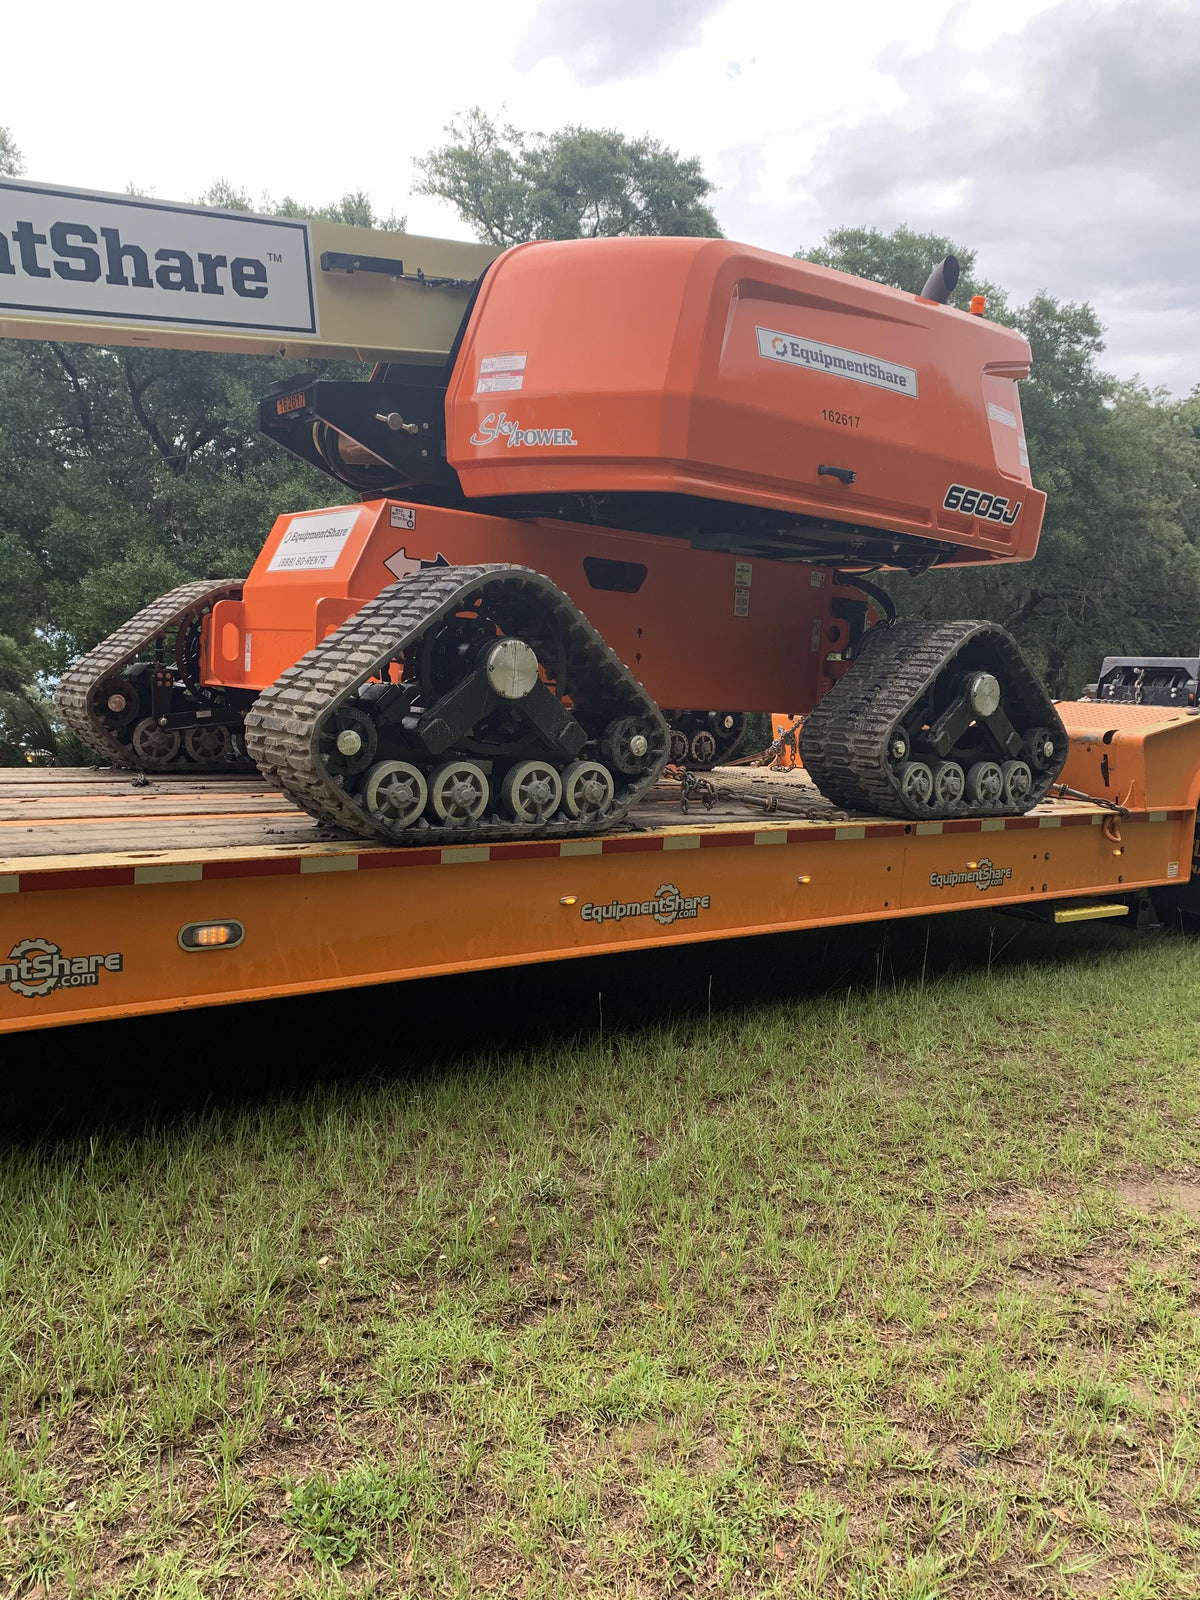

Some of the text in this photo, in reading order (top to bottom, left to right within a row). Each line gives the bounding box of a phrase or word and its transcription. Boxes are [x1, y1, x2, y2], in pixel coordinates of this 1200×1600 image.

[789, 342, 907, 387] EquipmentShare
[280, 393, 304, 412] 162617
[821, 409, 861, 428] 162617
[943, 484, 1022, 526] 660SJ
[290, 527, 349, 543] EquipmentShare
[929, 867, 1012, 888] EquipmentShare
[581, 894, 711, 924] EquipmentShare
[676, 909, 697, 919] .com
[0, 953, 123, 982] ntShare
[57, 973, 98, 986] .com
